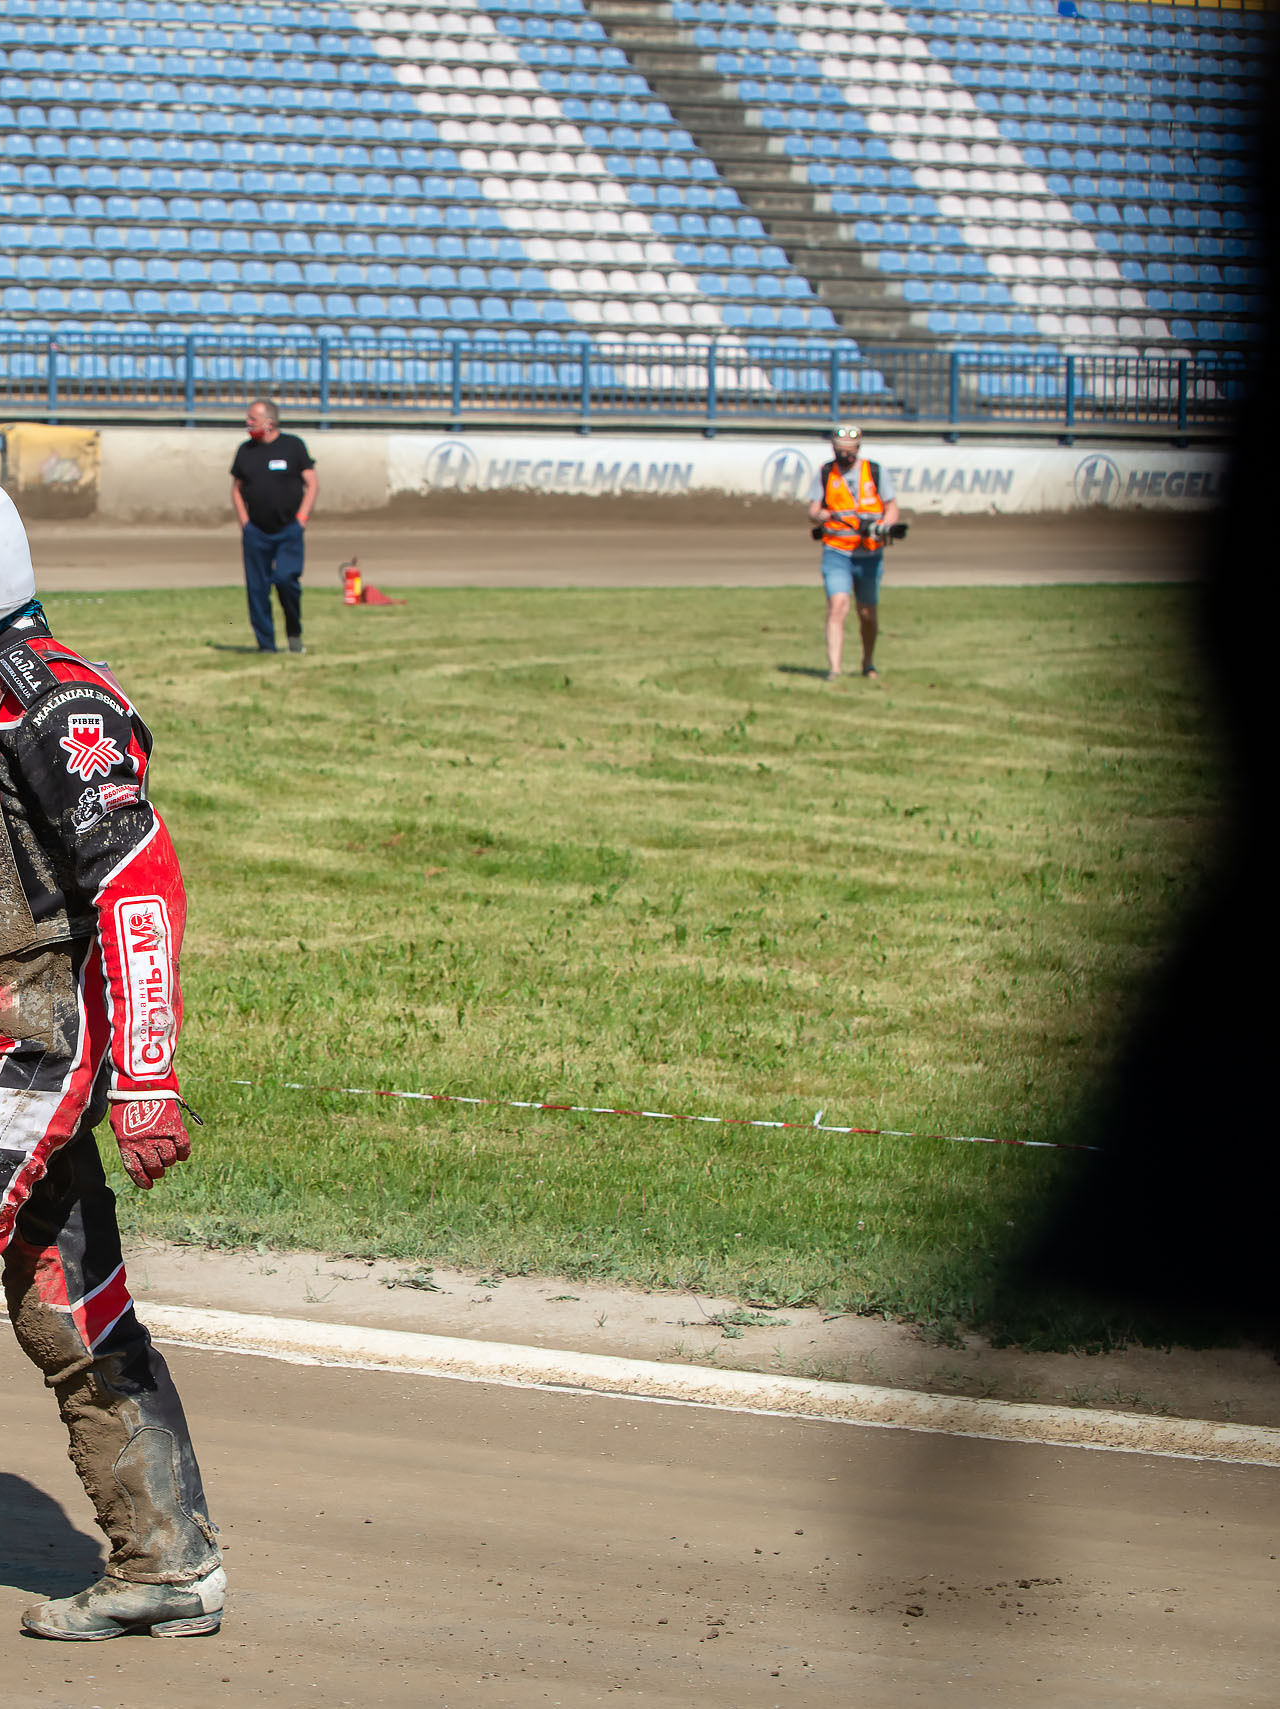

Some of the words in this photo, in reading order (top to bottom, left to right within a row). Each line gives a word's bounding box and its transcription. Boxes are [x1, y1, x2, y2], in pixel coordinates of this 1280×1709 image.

[486, 458, 694, 490] HEGELMANN
[887, 466, 1015, 495] ELMANN
[1126, 471, 1217, 497] HEGEL
